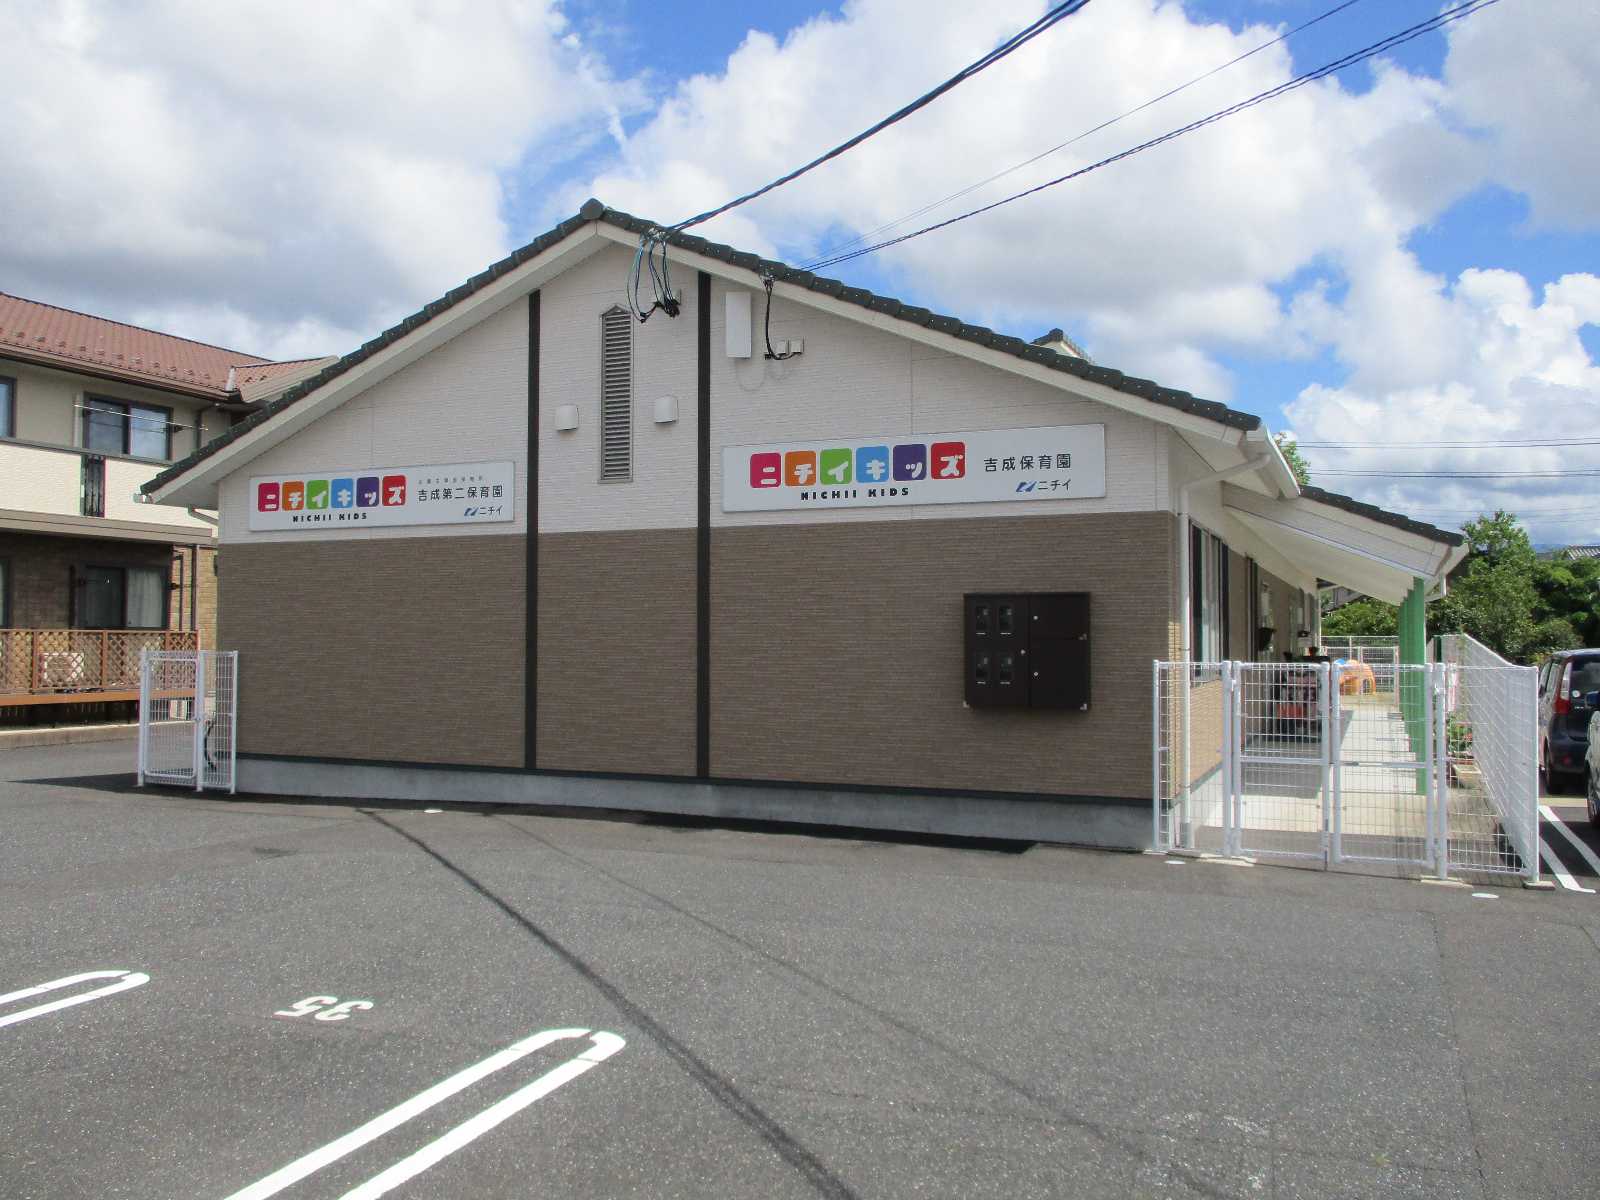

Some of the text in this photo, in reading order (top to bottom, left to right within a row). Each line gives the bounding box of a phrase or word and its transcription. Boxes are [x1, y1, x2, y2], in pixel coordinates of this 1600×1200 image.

[759, 453, 965, 486] ニチイキッズ
[983, 453, 1071, 472] 吉成保育園
[1037, 479, 1071, 491] ニチイ
[262, 484, 405, 510] ニチイキッズ
[418, 485, 503, 501] 吉成第二保育園
[801, 487, 909, 500] NICHII KIDS
[292, 512, 367, 522] NICHII KIDS
[479, 504, 503, 516] ニチイ
